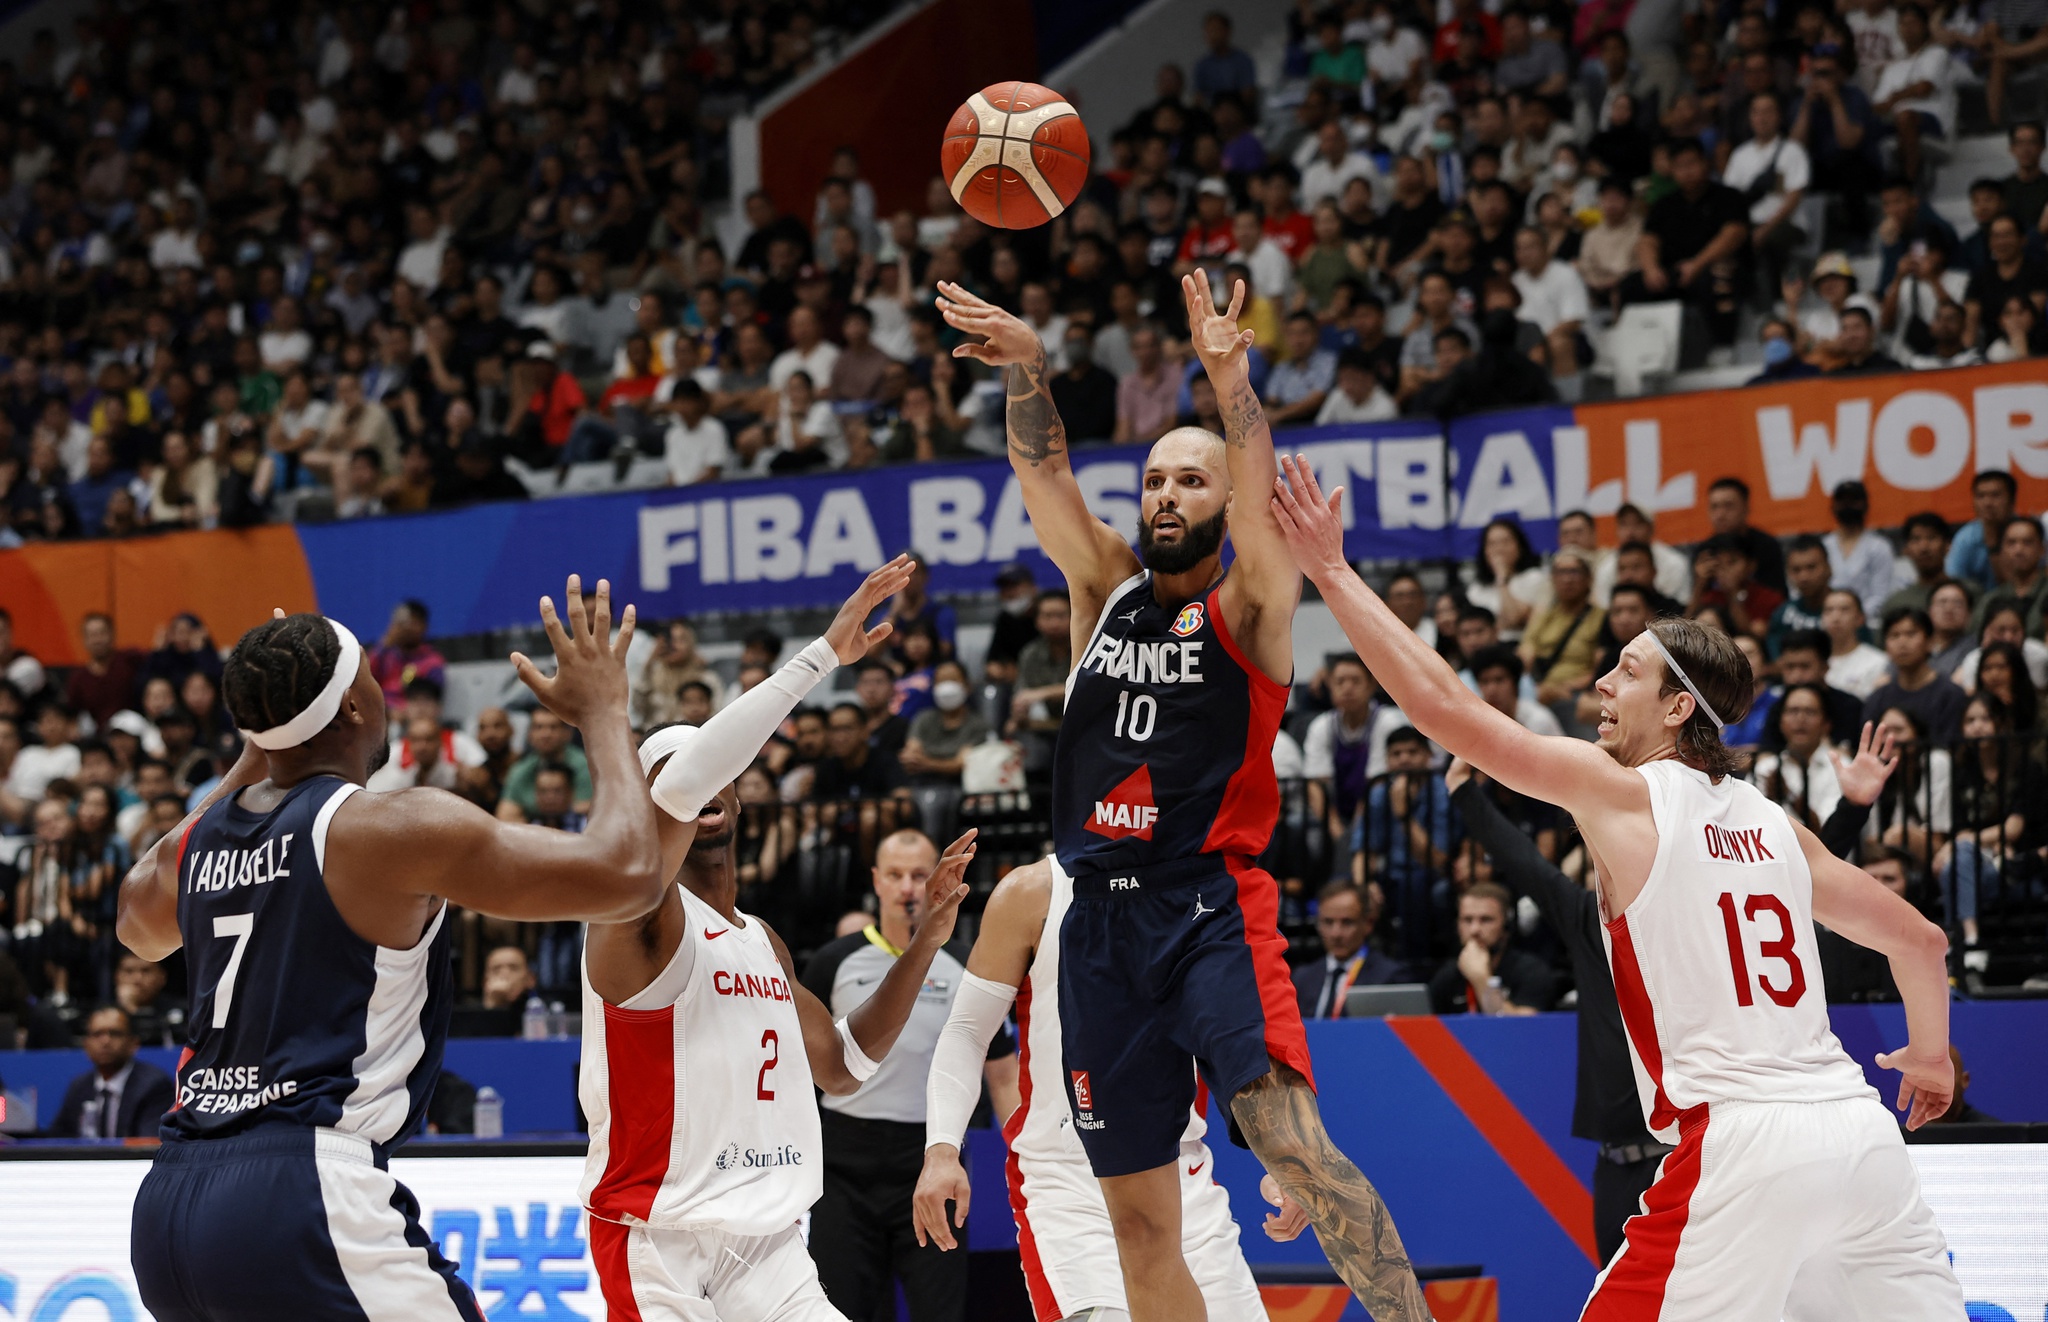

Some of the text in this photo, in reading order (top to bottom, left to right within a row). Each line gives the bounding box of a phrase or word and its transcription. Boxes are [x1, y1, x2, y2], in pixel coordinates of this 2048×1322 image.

[638, 488, 886, 592] FIBA
[909, 419, 1695, 566] BASTBALL
[1082, 632, 1204, 684] FRANCE
[1114, 690, 1157, 741] 10
[1095, 801, 1159, 830] MAIF
[1109, 876, 1140, 891] FRA
[213, 912, 254, 1029] 7
[1717, 892, 1807, 1007] 13
[713, 970, 792, 1004] CANADA
[187, 1066, 260, 1091] CAISSE
[757, 1029, 779, 1101] 2
